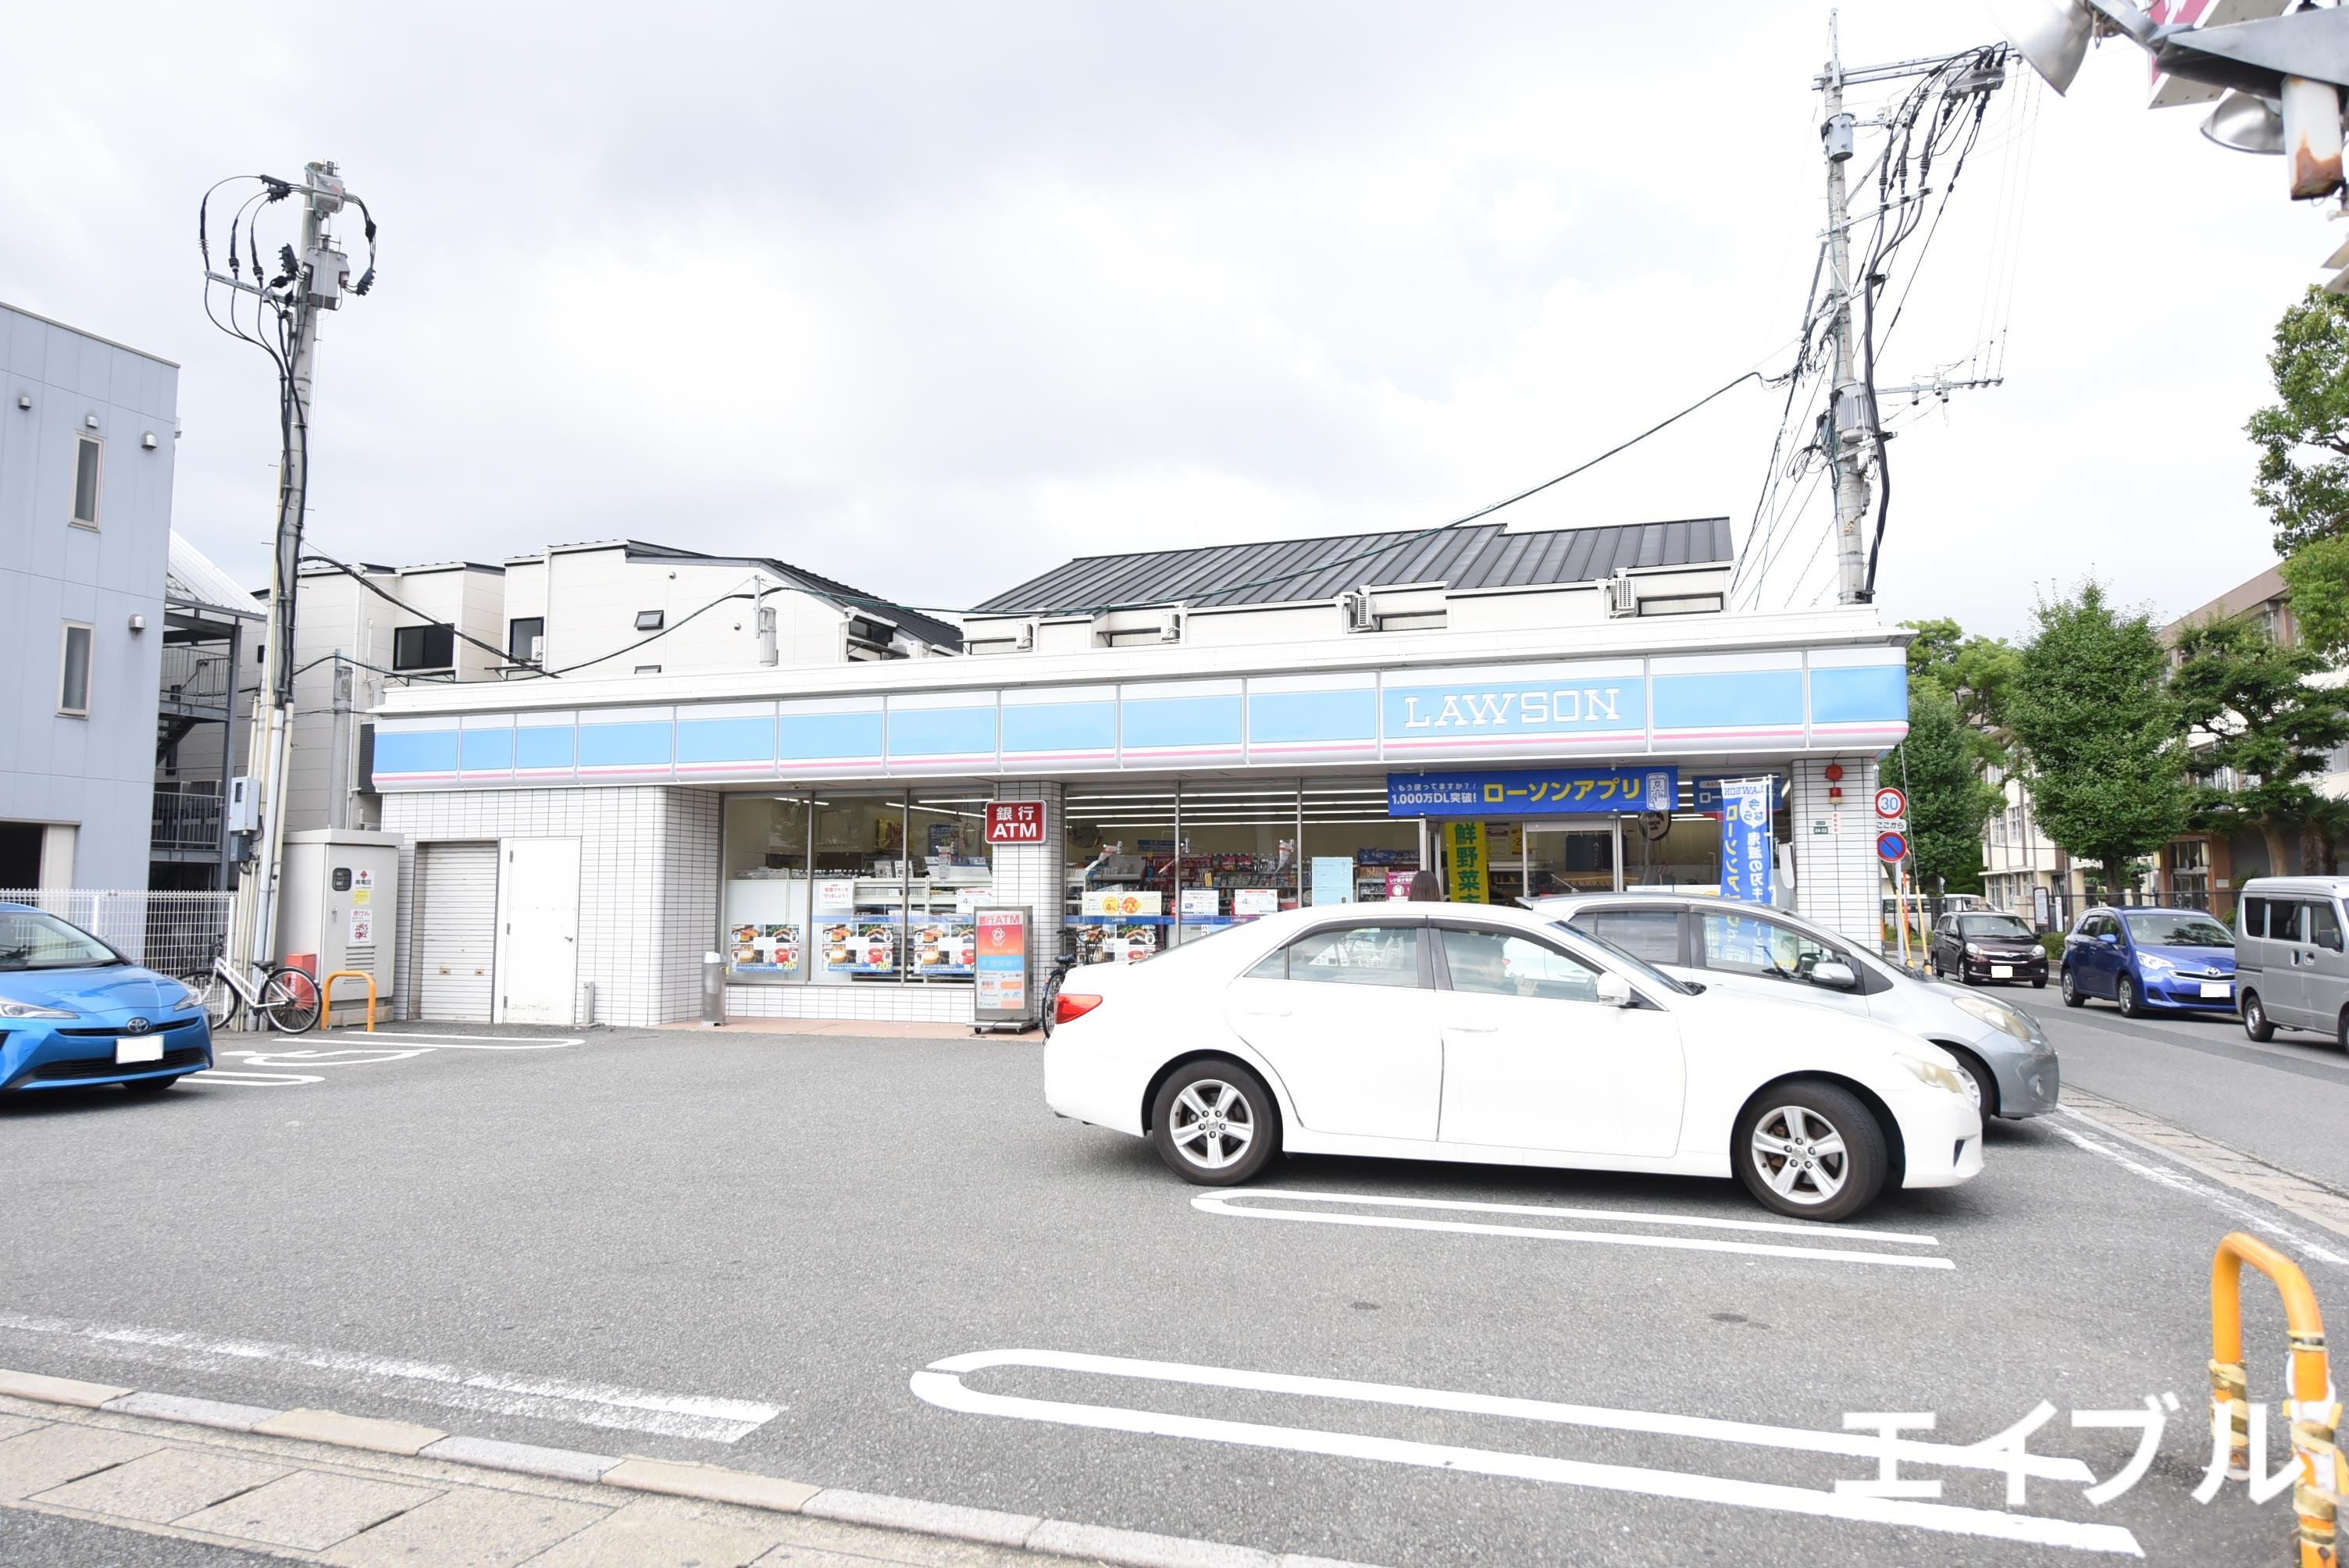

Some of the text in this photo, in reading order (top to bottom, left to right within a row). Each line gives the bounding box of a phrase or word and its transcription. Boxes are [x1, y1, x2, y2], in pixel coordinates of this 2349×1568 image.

[1404, 687, 1621, 729] LAWSON
[1483, 776, 1640, 803] ローソンアプリ
[1880, 796, 1898, 811] 30
[996, 806, 1034, 821] 銀行
[993, 822, 1037, 838] ATM
